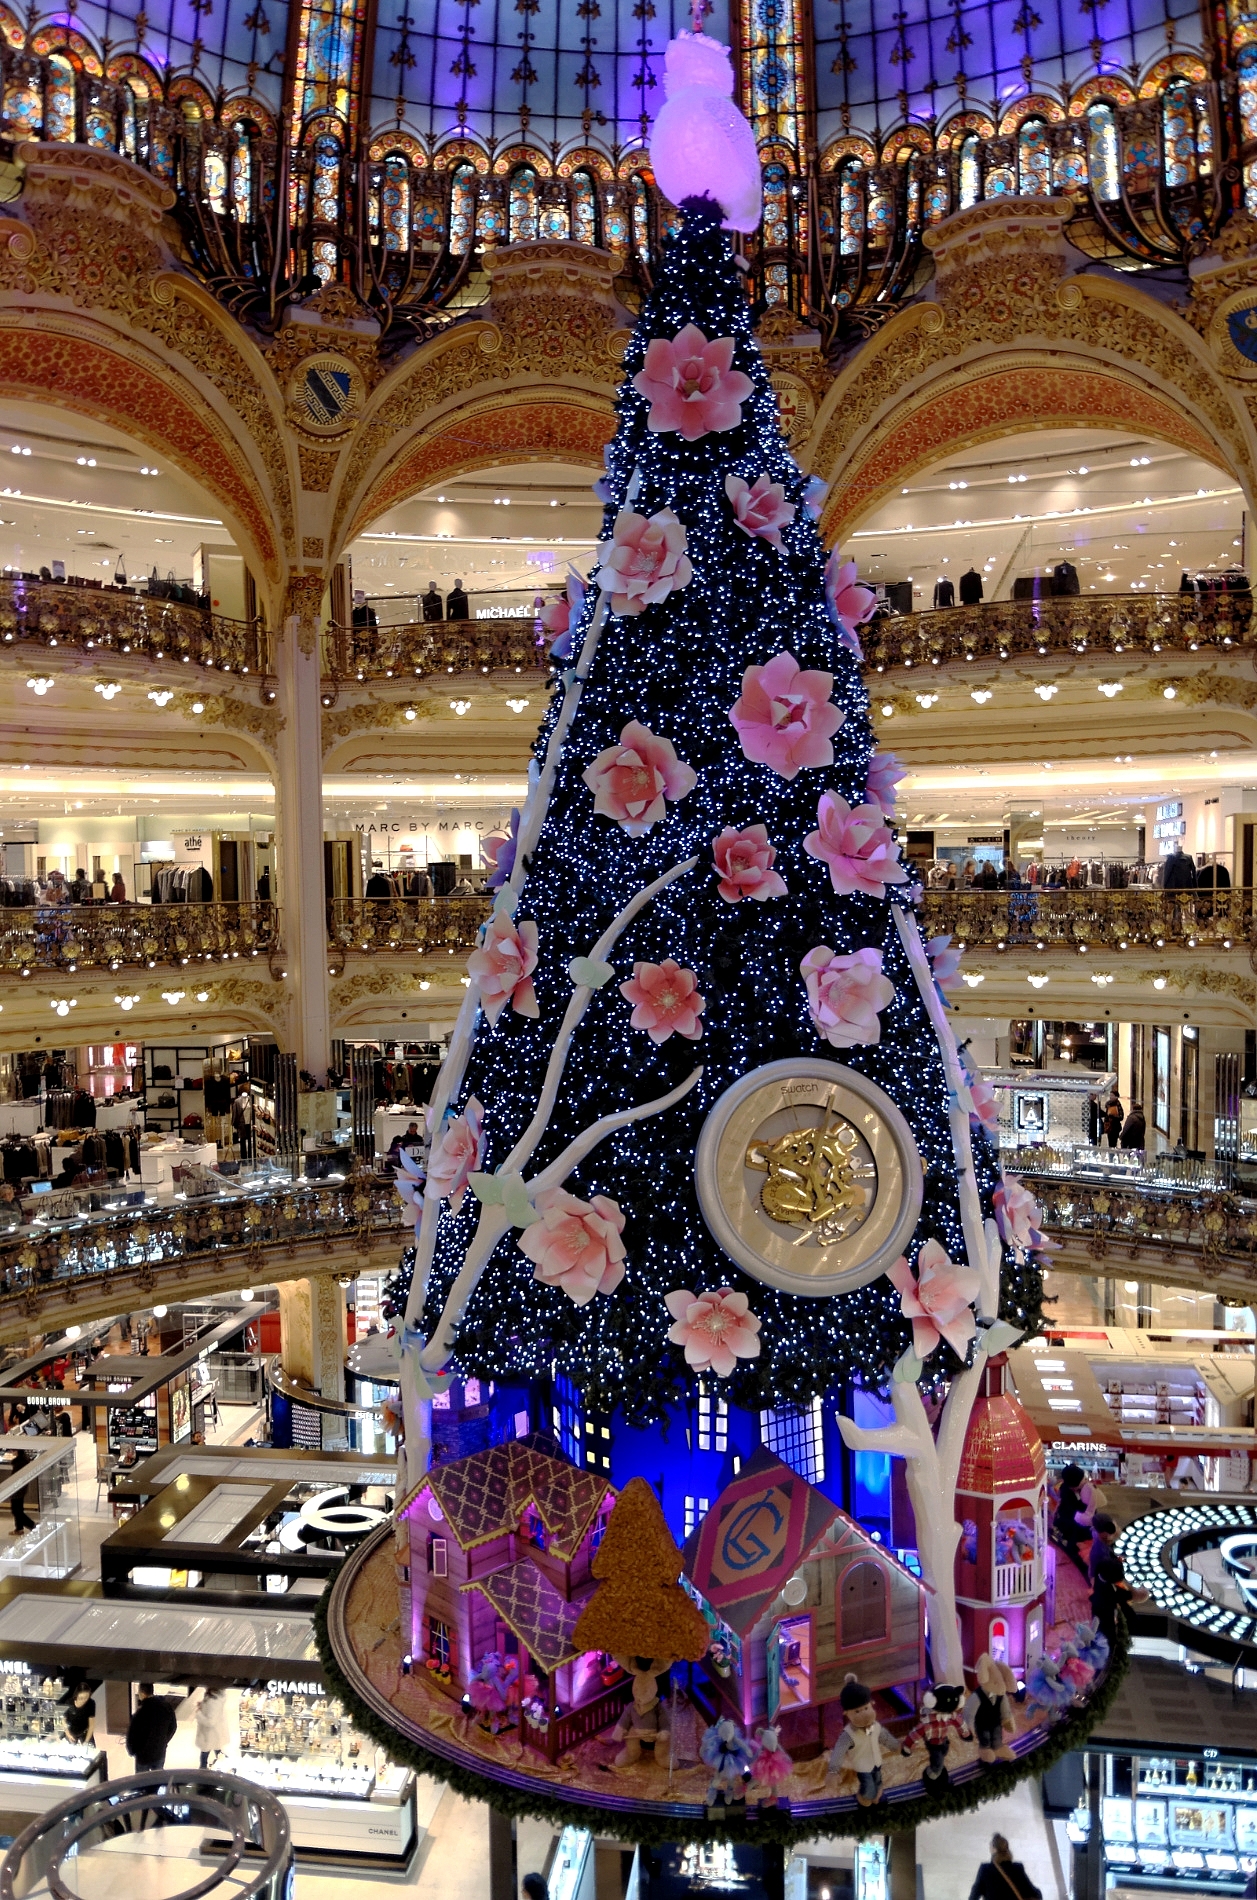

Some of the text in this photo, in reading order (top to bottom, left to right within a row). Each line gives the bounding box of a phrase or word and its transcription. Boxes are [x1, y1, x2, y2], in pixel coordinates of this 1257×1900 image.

[476, 604, 531, 619] MICHAEL
[355, 823, 400, 832] MARC
[409, 822, 430, 832] BY
[438, 821, 484, 831] MARC
[780, 1083, 819, 1095] swatch
[26, 1396, 72, 1406] BOBBI BROWN
[1052, 1441, 1107, 1452] CLARINS
[267, 1679, 326, 1696] CHANEL
[368, 1828, 399, 1836] CHANEL
